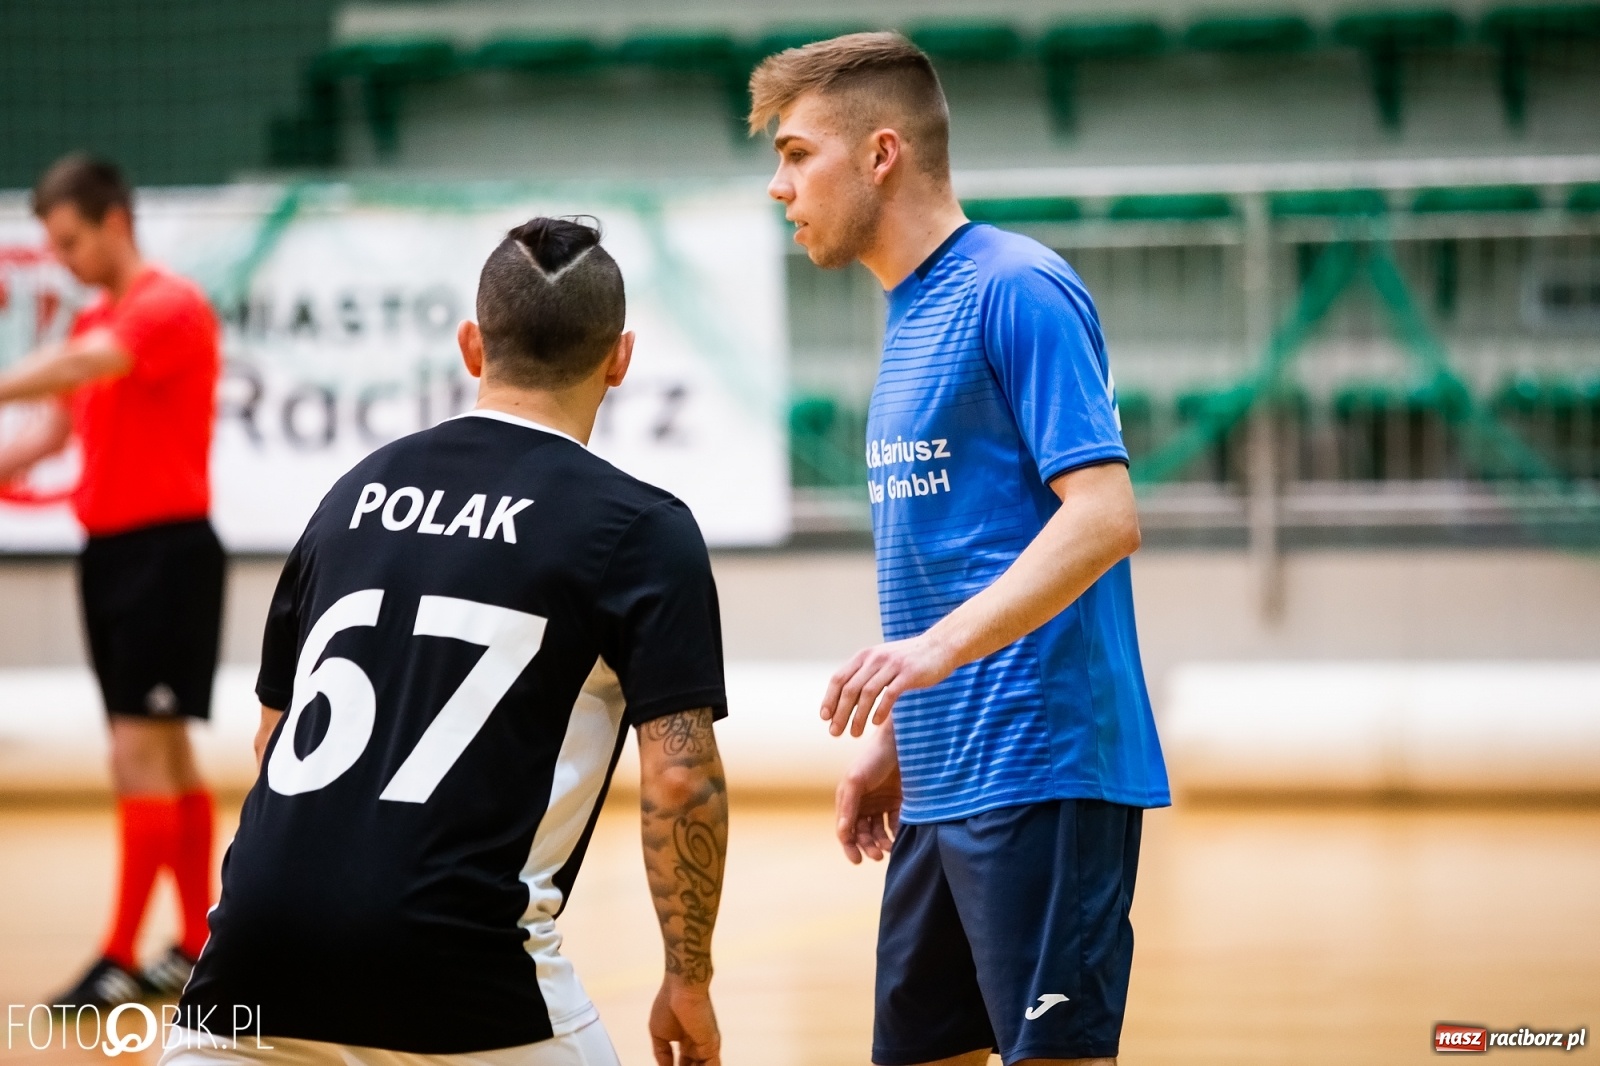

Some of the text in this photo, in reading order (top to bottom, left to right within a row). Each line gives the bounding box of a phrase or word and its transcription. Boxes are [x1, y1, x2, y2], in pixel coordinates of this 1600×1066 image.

[349, 482, 535, 544] POLAK
[887, 469, 951, 499] GmbH
[267, 588, 549, 804] 67
